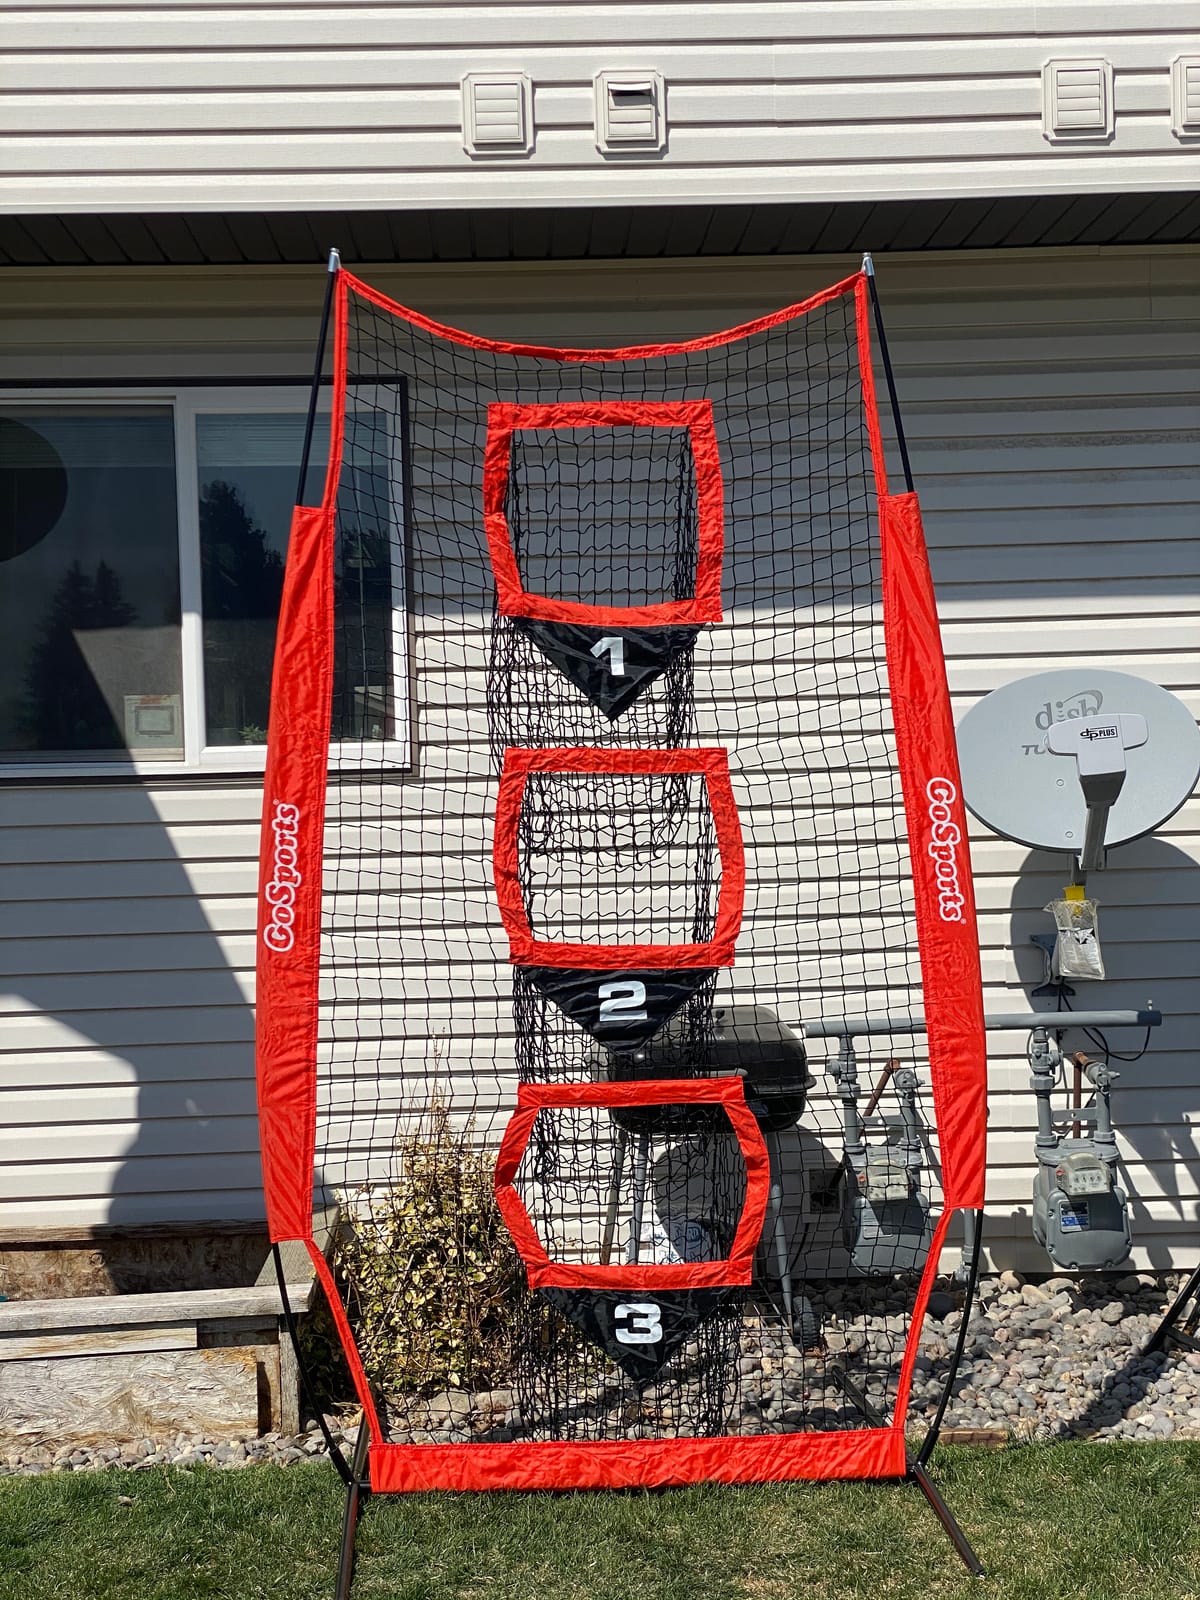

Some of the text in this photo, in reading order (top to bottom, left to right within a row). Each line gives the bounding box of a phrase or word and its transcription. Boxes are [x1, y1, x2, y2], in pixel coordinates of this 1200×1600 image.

[589, 636, 625, 676] 1
[1098, 728, 1116, 737] PLUS
[598, 980, 648, 1022] 2
[614, 1303, 663, 1344] 3
